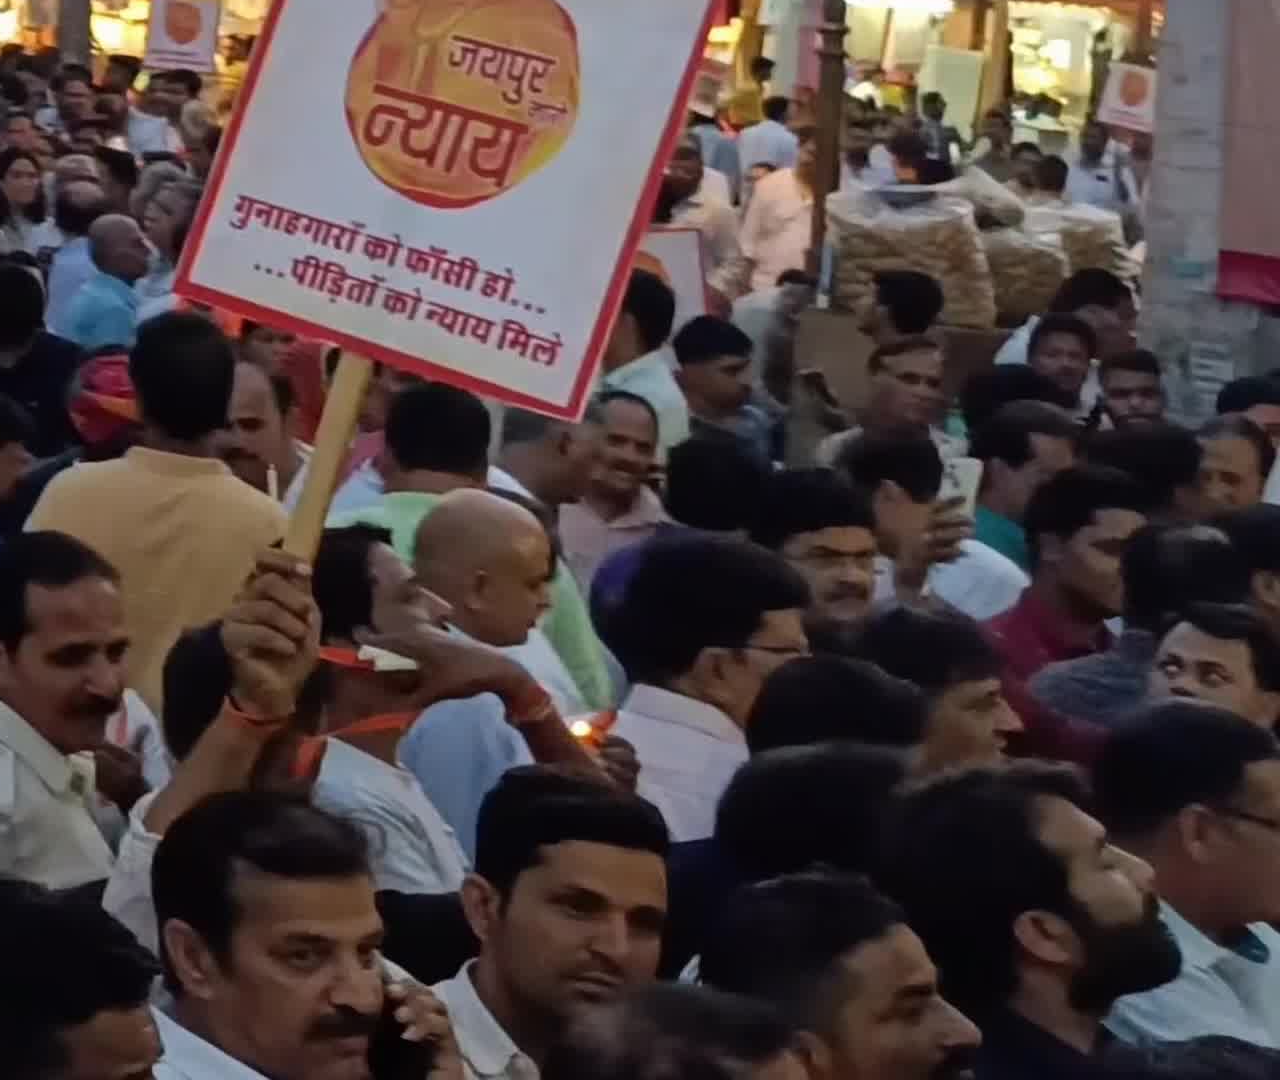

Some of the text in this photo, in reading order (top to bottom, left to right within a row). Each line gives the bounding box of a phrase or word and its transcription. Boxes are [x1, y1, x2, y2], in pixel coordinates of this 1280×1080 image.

[448, 34, 556, 104] जयपुर
[361, 84, 530, 188] न्याय
[363, 233, 403, 267] को
[381, 286, 423, 320] को
[425, 300, 496, 345] न्याय
[497, 318, 563, 366] मिले
